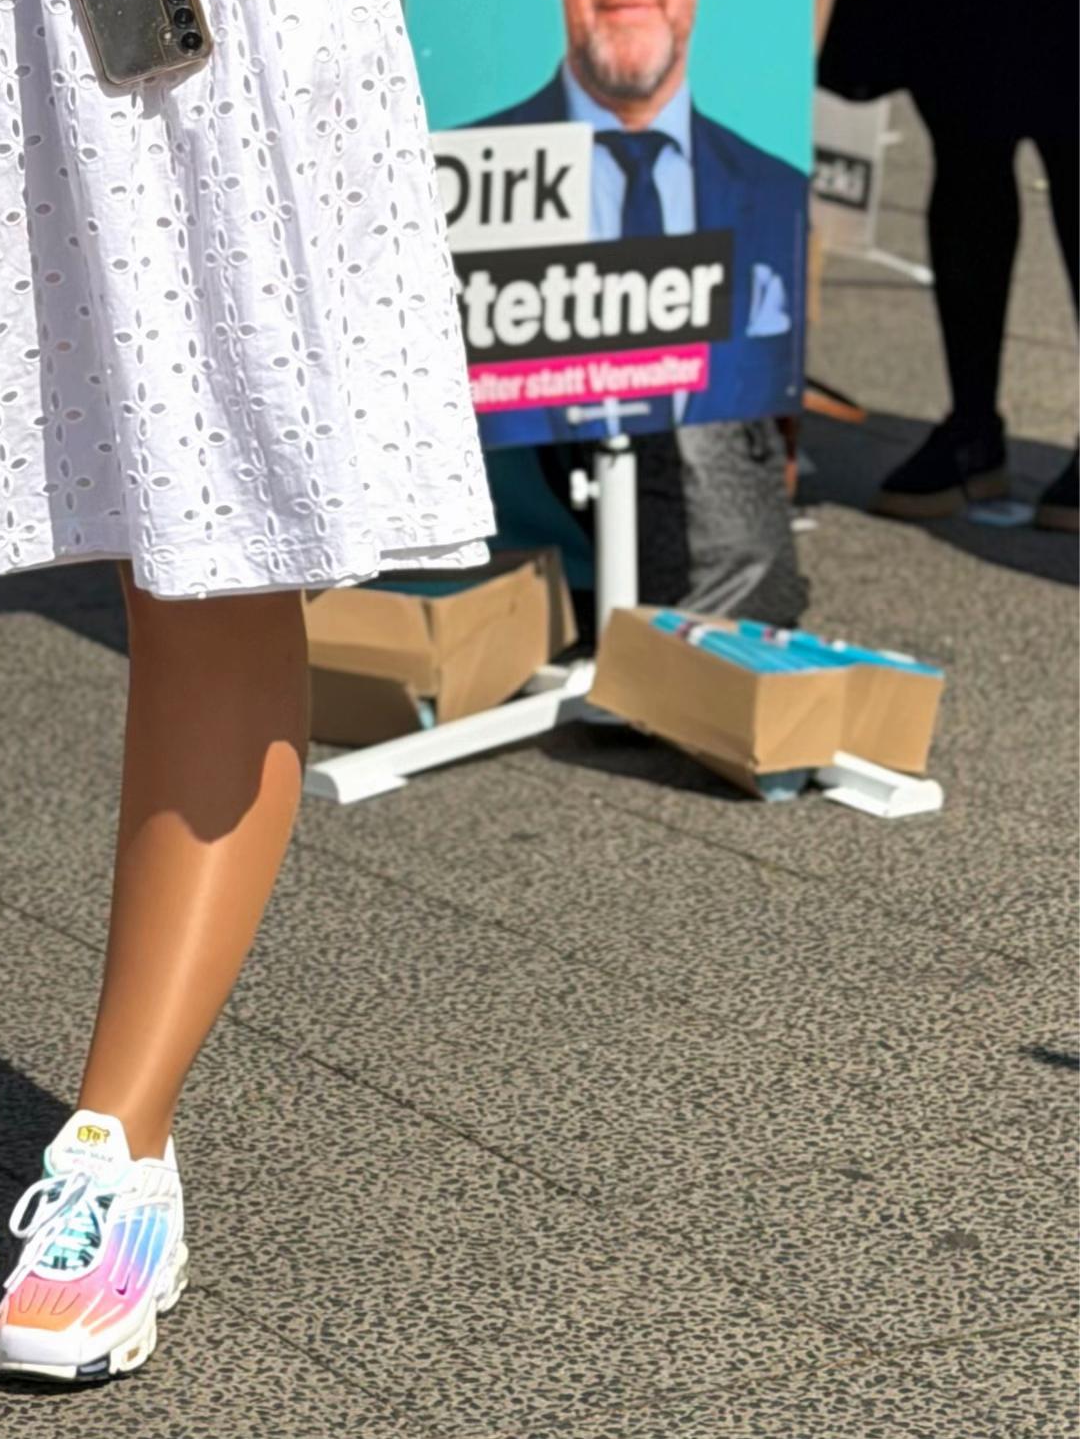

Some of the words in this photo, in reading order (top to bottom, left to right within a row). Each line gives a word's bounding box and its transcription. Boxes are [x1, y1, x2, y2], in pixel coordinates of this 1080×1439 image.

[459, 262, 724, 348] tettner
[472, 372, 522, 405] alter
[525, 364, 586, 399] statt
[587, 355, 703, 393] Verwalter
